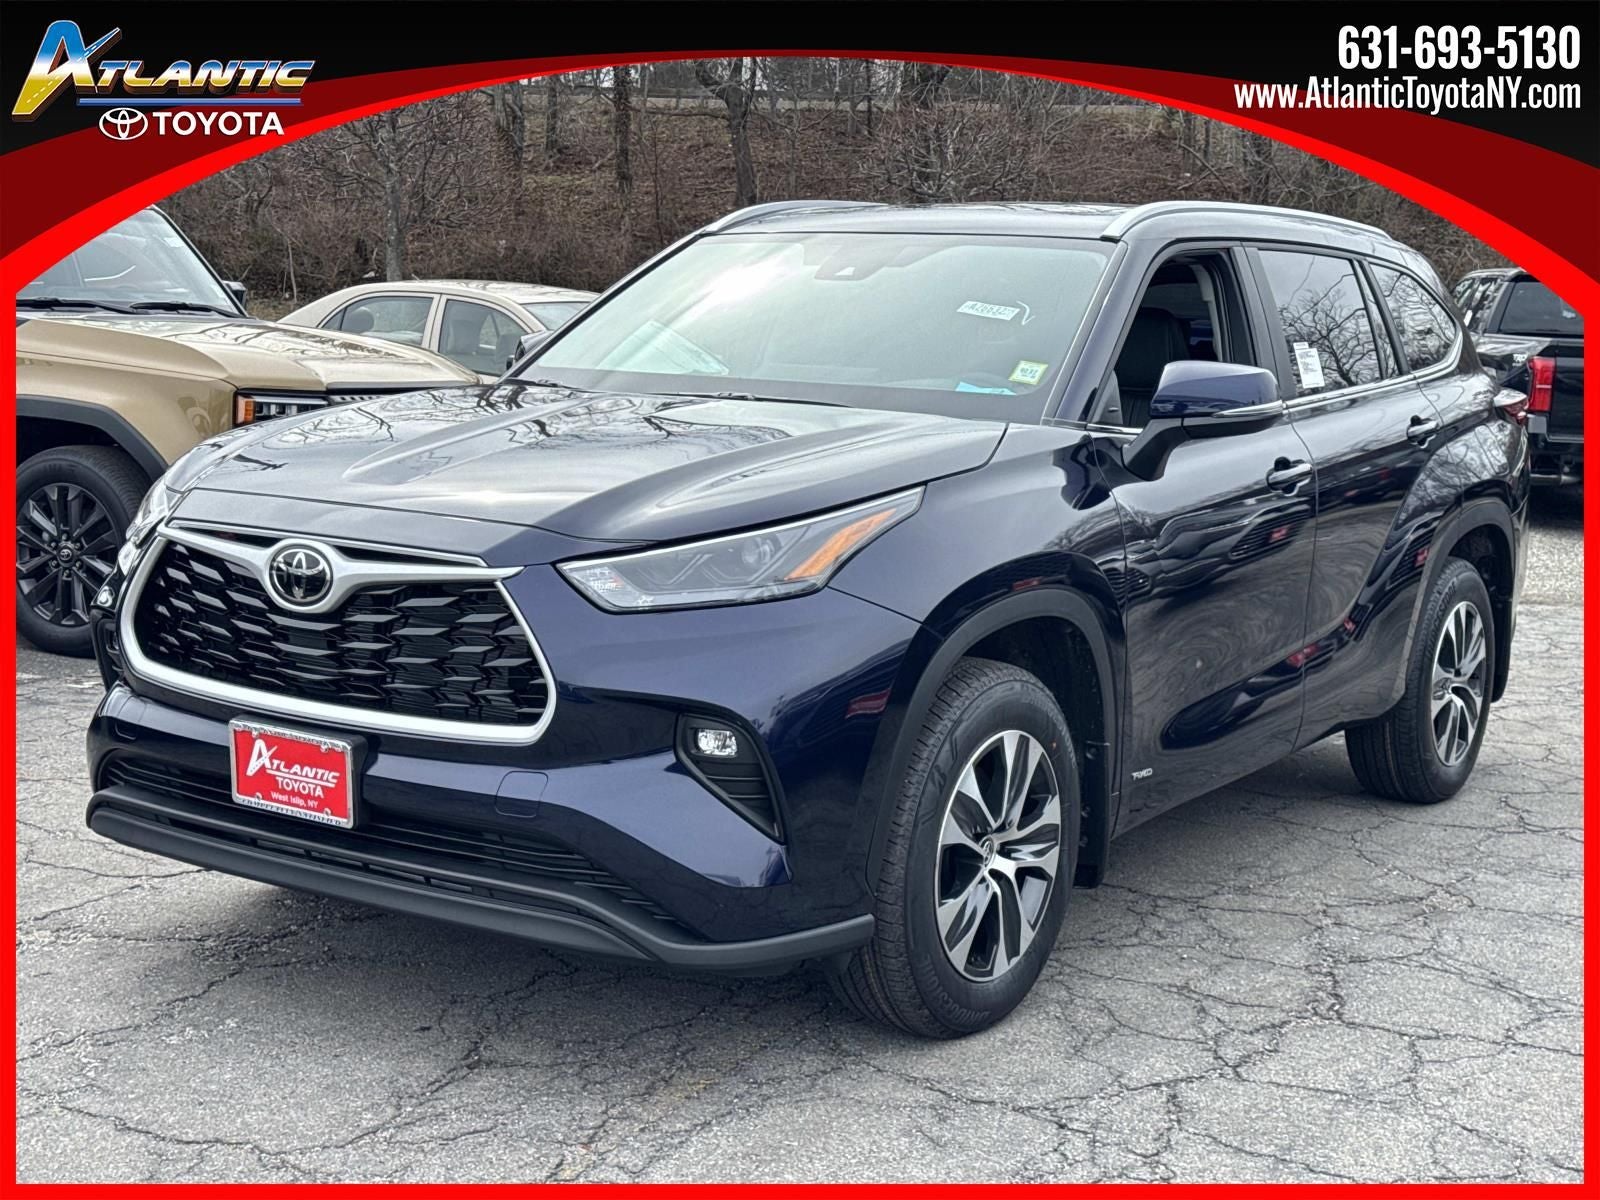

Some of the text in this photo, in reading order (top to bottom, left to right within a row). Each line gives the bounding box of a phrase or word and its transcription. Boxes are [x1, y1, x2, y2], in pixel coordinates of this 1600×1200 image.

[246, 739, 340, 783] ATLANTIC
[275, 776, 324, 799] TOYOTA
[270, 790, 289, 803] West
[307, 799, 319, 809] NY
